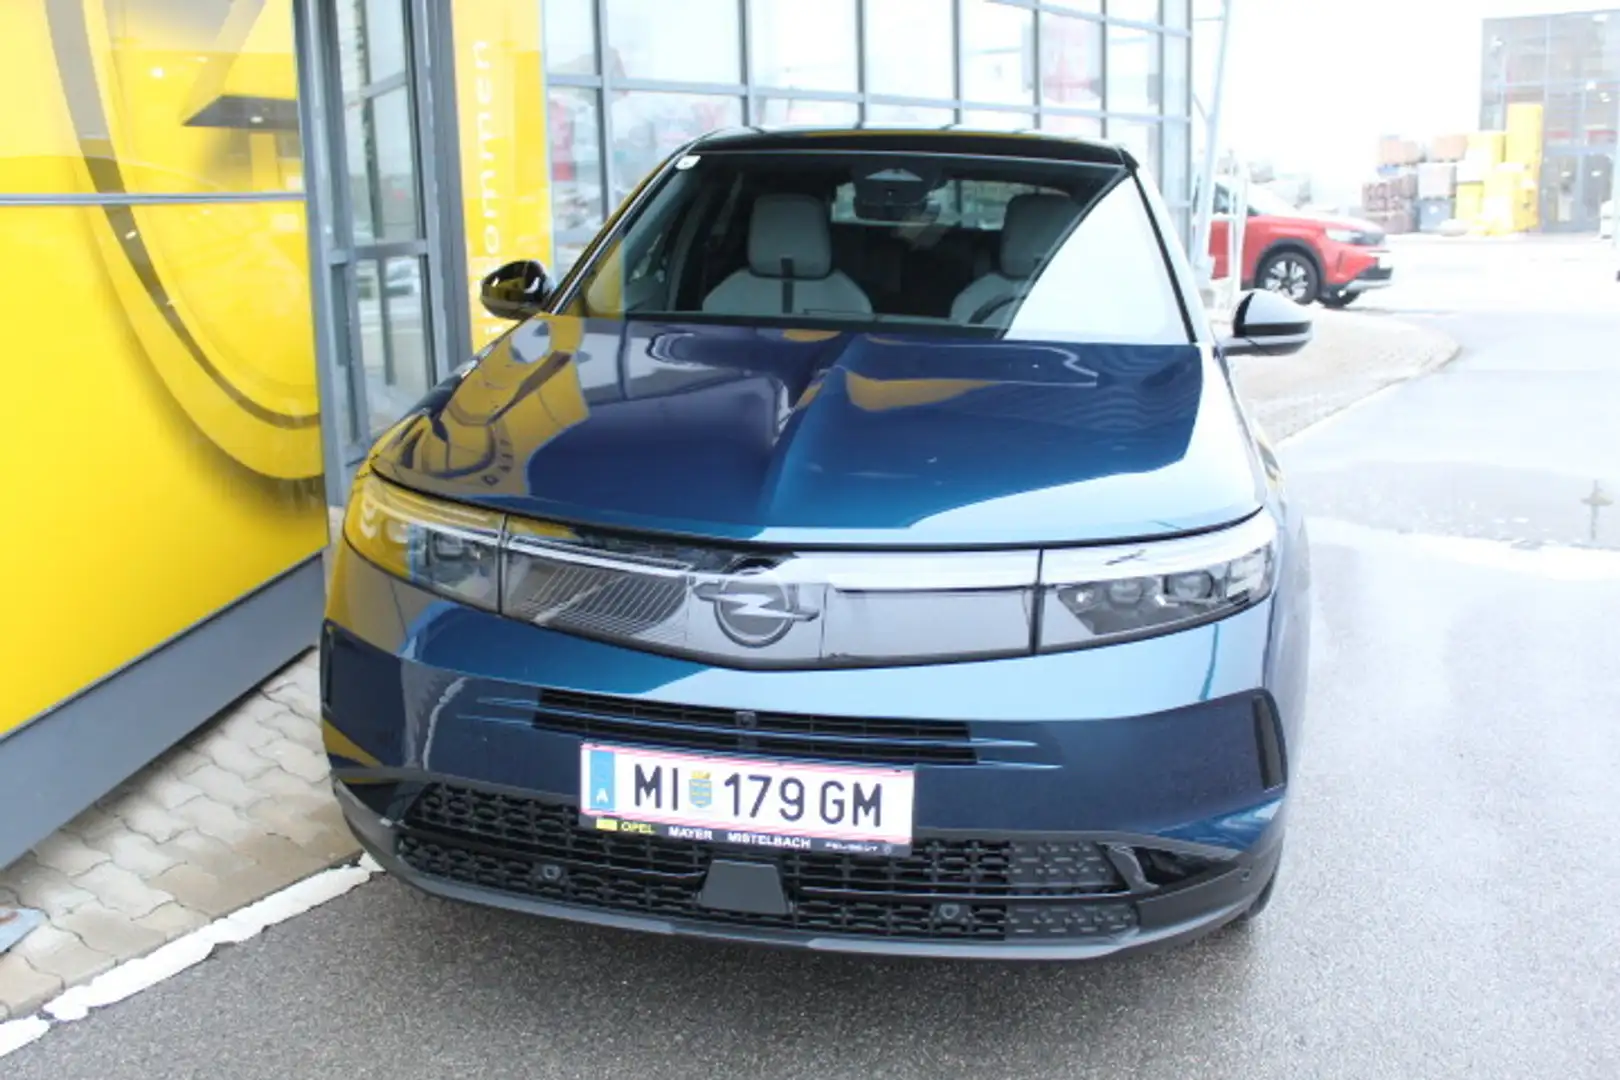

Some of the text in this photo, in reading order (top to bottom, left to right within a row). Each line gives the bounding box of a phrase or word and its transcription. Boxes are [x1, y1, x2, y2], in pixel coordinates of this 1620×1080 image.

[596, 788, 609, 804] A
[634, 763, 882, 827] MI 179 GM
[620, 821, 655, 834] OPEL
[668, 826, 713, 841] MAYER
[727, 831, 811, 849] MISTELBACH
